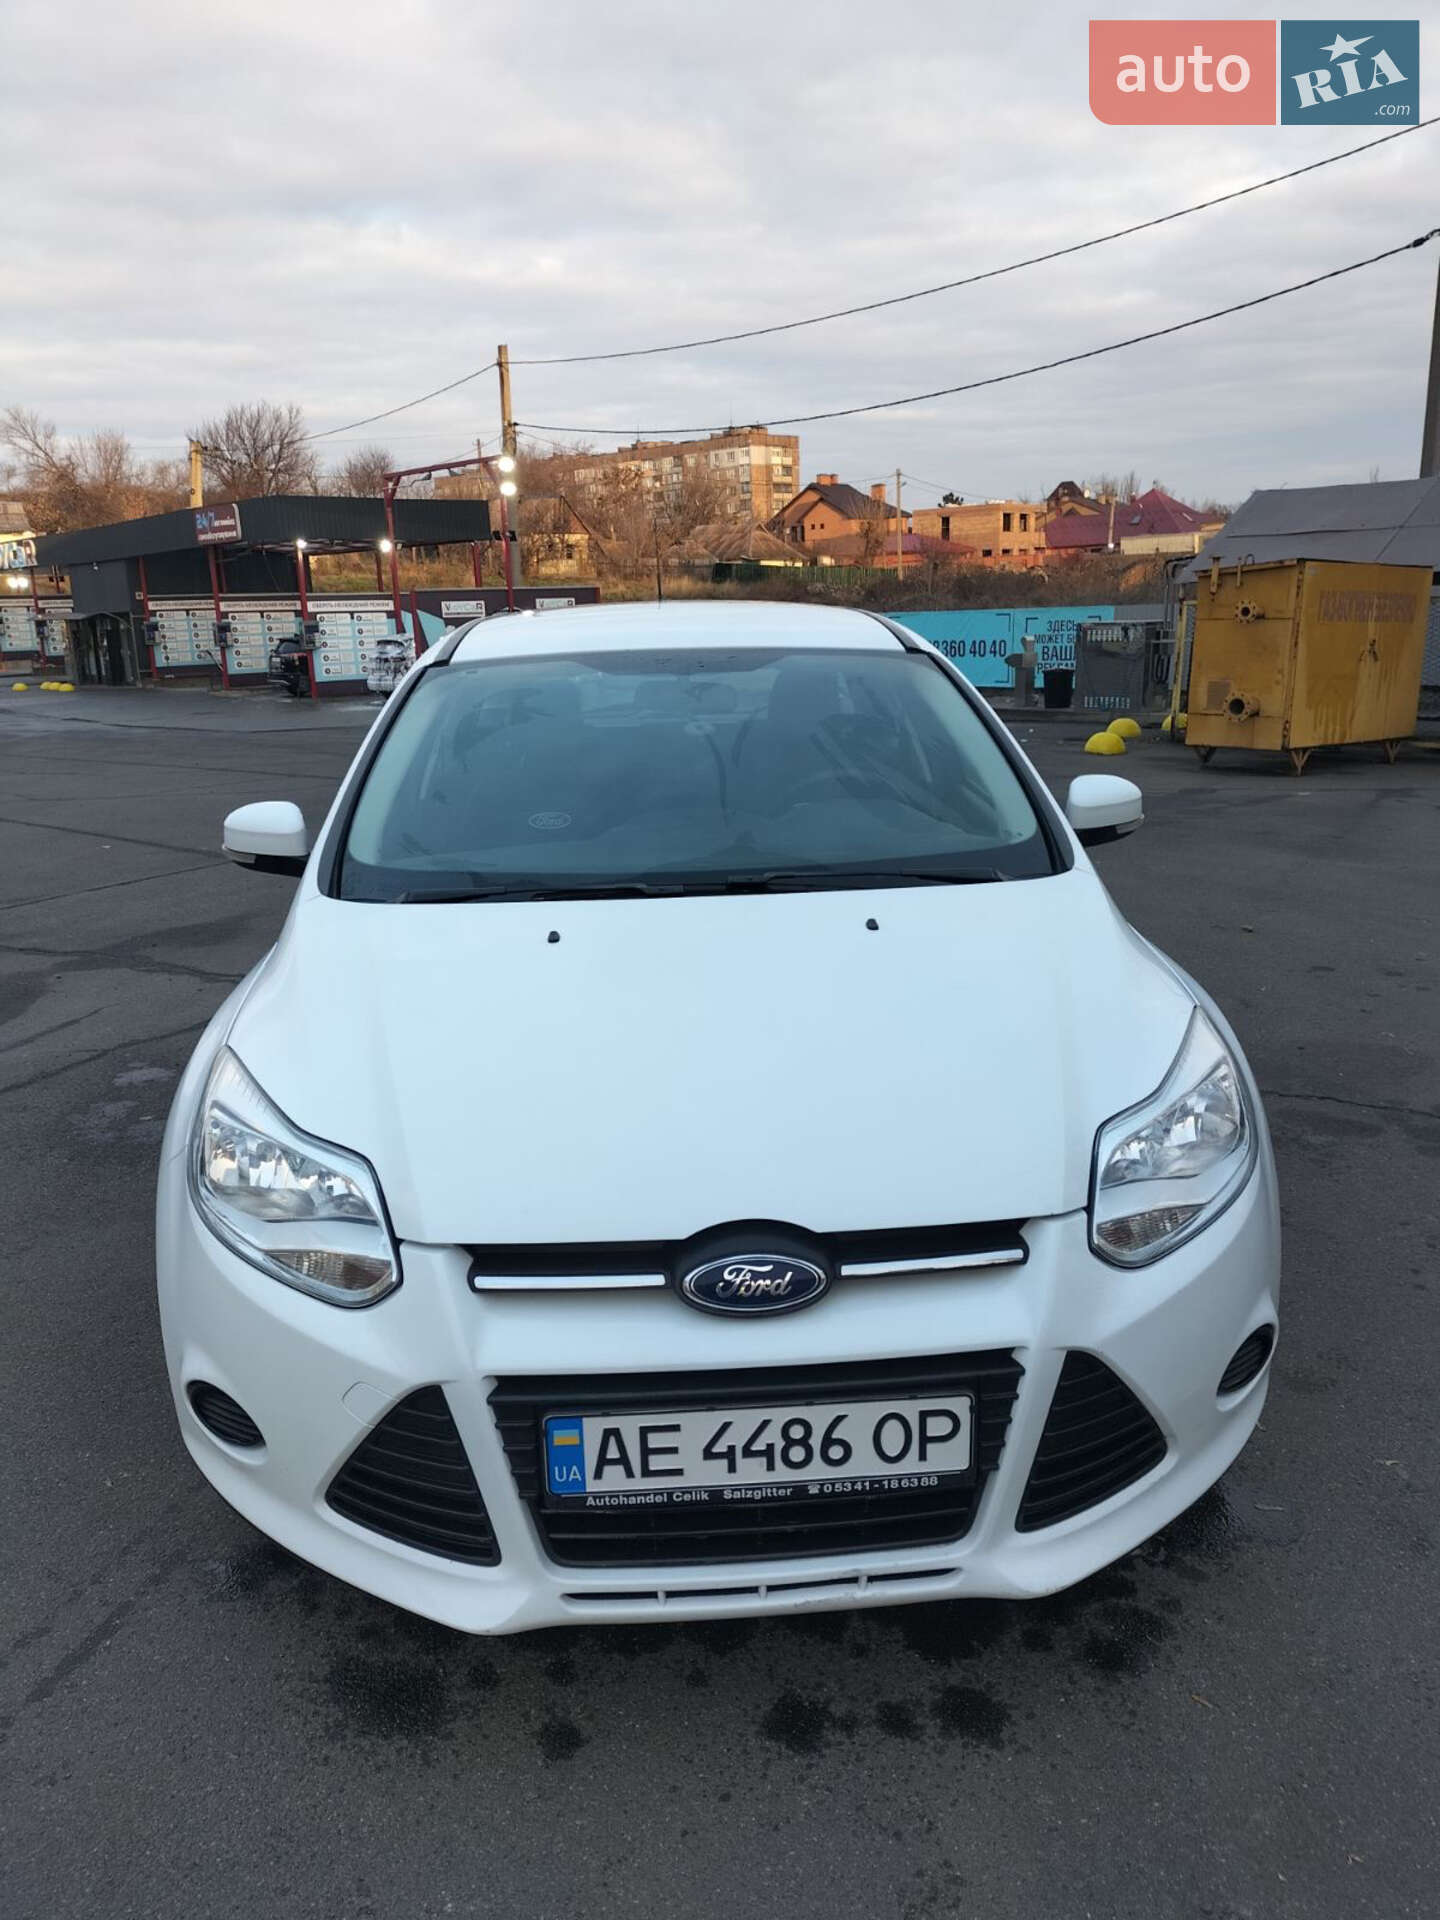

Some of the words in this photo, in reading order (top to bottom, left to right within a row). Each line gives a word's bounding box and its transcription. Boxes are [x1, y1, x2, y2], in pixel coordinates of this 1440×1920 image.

[969, 639, 987, 658] 40
[989, 639, 1007, 658] 40
[715, 1264, 793, 1298] Ford
[593, 1423, 685, 1481] AE
[702, 1413, 854, 1474] 4486
[872, 1408, 961, 1464] OP
[554, 1465, 582, 1482] UA
[586, 1493, 668, 1506] Autohandel
[672, 1490, 710, 1502] Celik
[723, 1486, 793, 1500] Salzgitter
